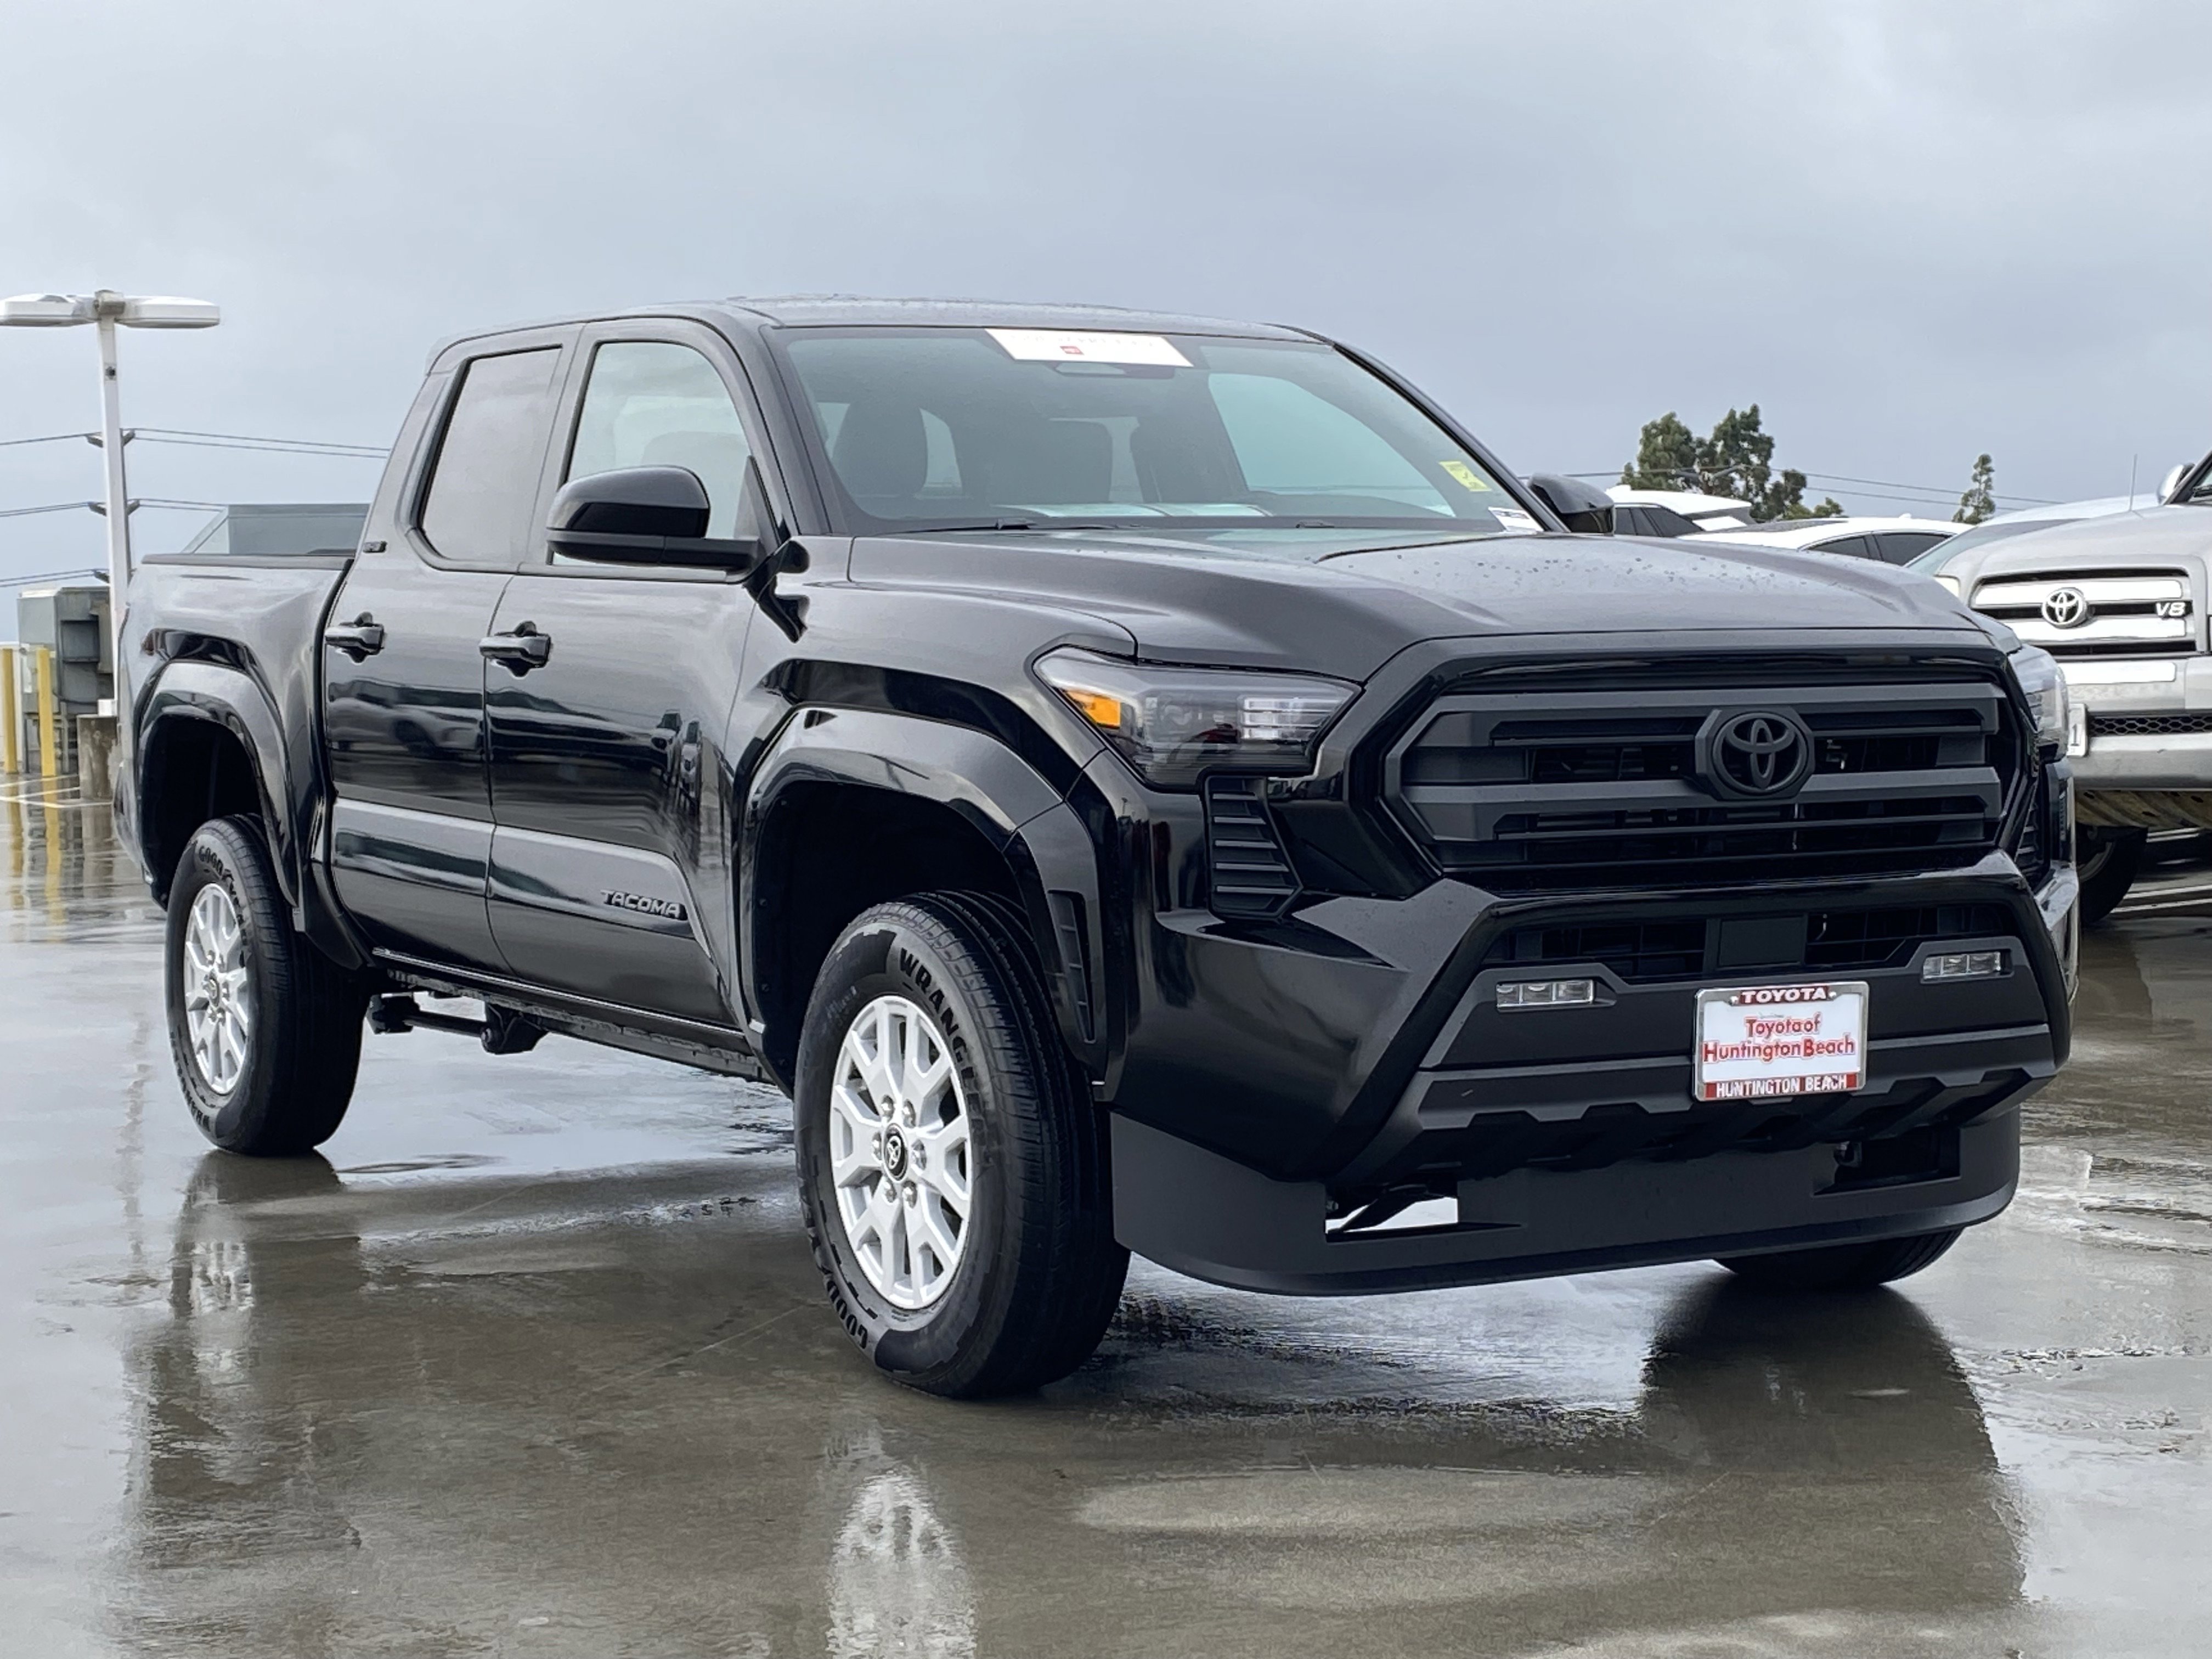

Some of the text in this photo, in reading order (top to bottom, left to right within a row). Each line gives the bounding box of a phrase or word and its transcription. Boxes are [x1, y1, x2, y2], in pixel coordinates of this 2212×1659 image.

[2155, 602, 2186, 616] V8
[600, 889, 681, 919] TACOMA
[1742, 988, 1827, 1004] TOYOTA
[1745, 1012, 1821, 1039] Toyota of
[900, 947, 987, 1147] WRANGLER
[1704, 1034, 1854, 1062] Huntington Beach
[1716, 1075, 1847, 1098] HUNTINGTON BEACH
[799, 1180, 868, 1350] GOODYEA
